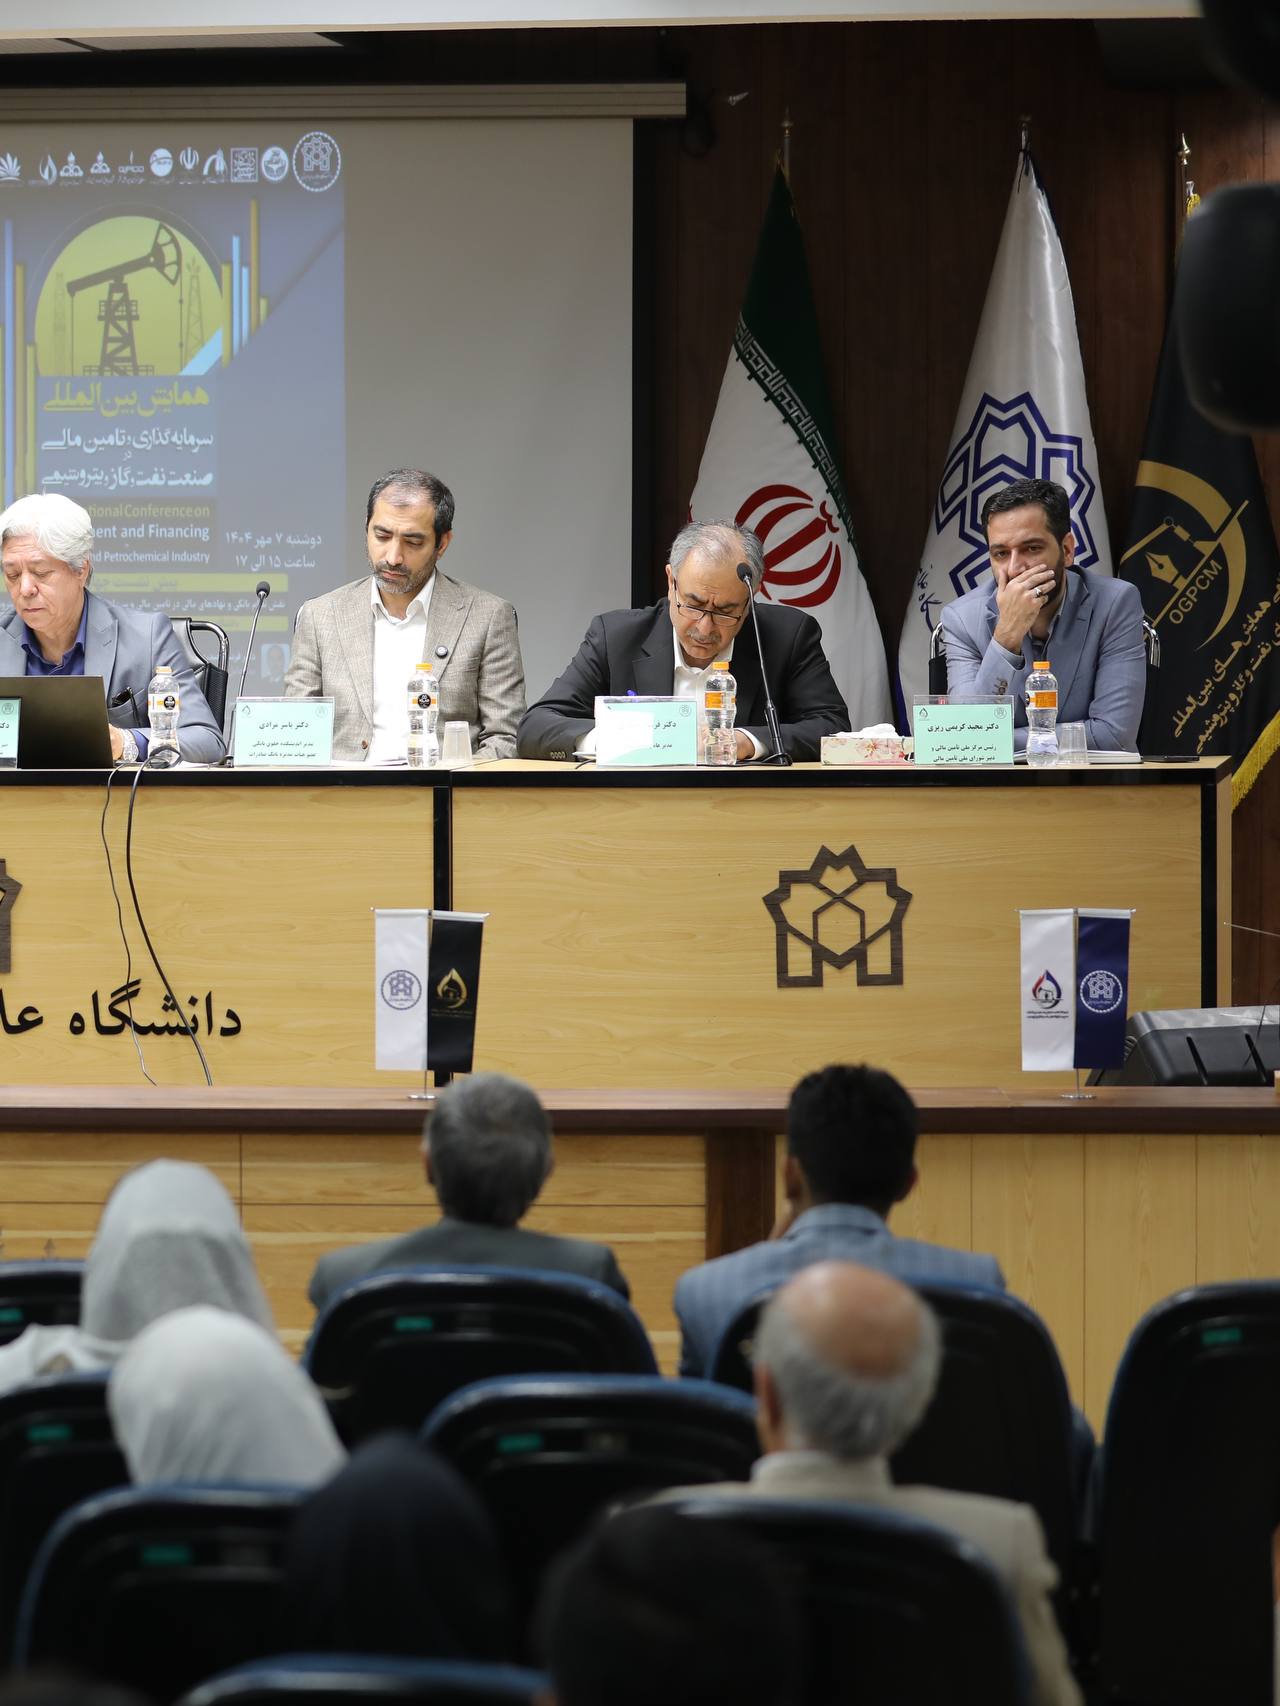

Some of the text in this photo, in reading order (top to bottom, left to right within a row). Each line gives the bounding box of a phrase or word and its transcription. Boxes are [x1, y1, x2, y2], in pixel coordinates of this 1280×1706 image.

[137, 382, 209, 417] همایش
[41, 428, 82, 450] مالی
[83, 427, 126, 453] تامین
[109, 466, 131, 490] گاز
[136, 468, 165, 486] نفت
[168, 470, 213, 486] صنعت
[125, 504, 193, 517] Conference
[194, 507, 210, 517] on
[121, 524, 145, 538] and
[149, 524, 210, 541] Financing
[286, 533, 322, 549] دوشنبه
[104, 551, 169, 562] Petrochemical
[172, 551, 210, 563] Industry
[284, 555, 315, 568] ساعت
[1170, 560, 1222, 624] OGPCM
[1242, 601, 1271, 646] همایش
[295, 721, 309, 730] دکتر
[662, 720, 676, 729] دکتر
[985, 723, 999, 731] دکتر
[69, 978, 242, 1037] دانشگاه
